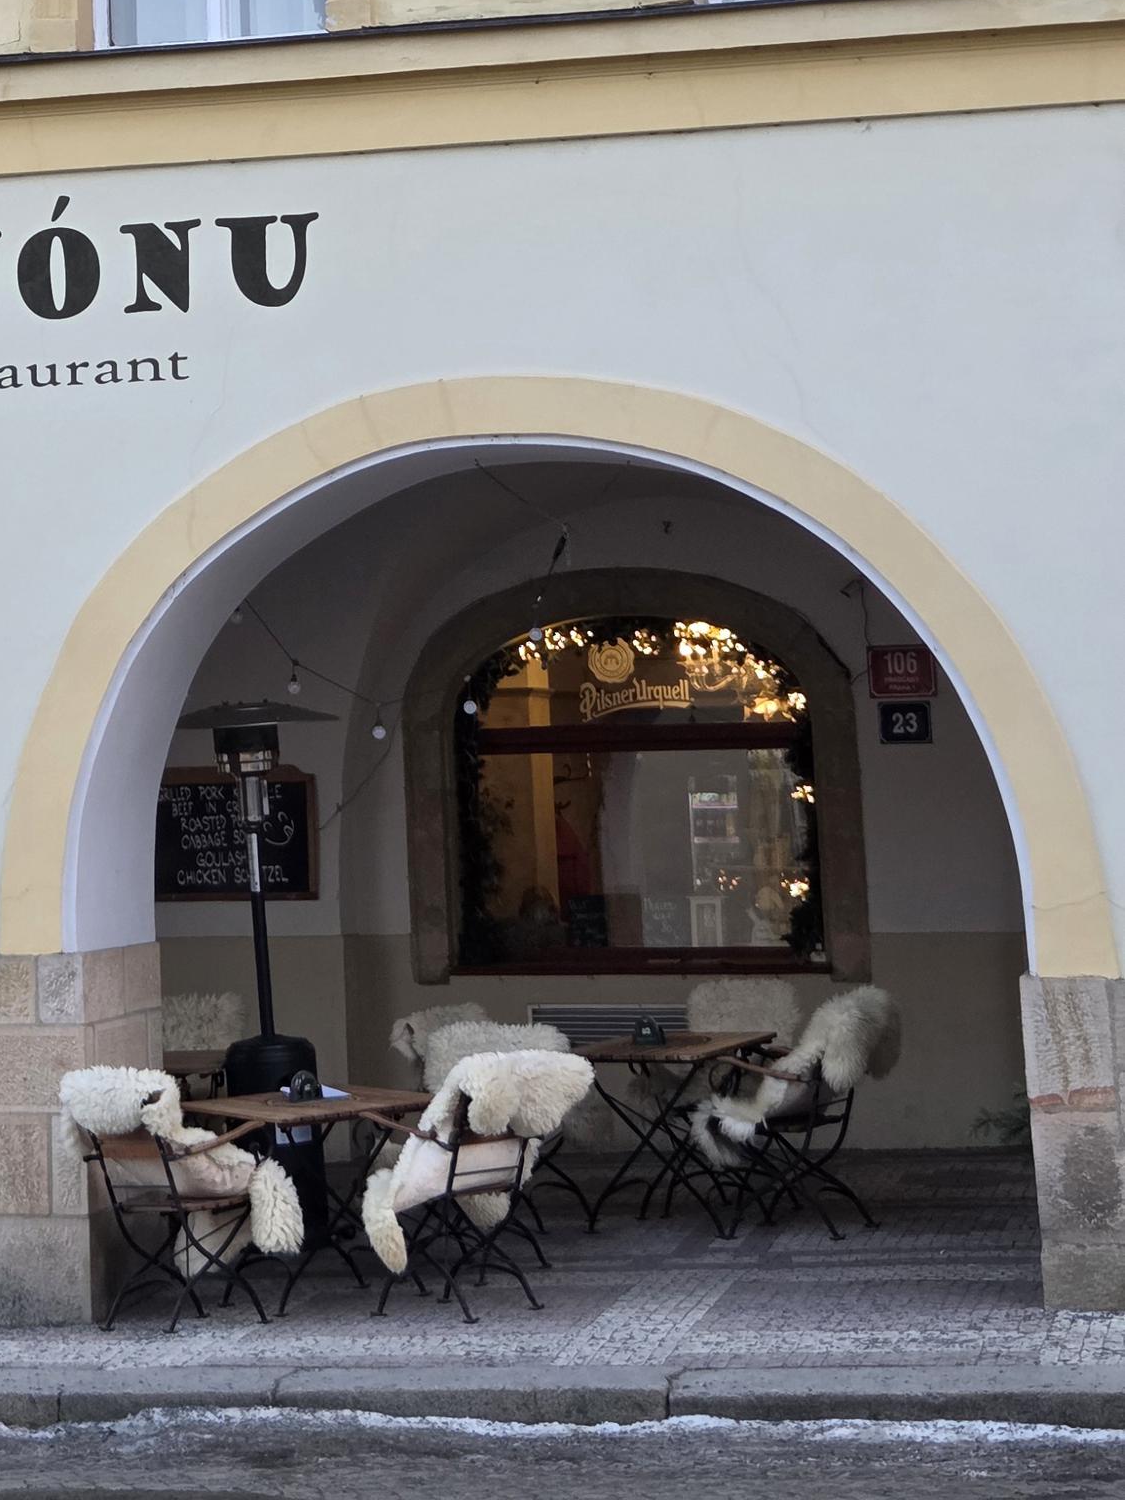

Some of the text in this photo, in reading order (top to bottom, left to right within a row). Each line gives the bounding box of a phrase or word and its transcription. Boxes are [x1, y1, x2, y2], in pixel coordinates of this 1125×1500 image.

[883, 651, 917, 674] 106
[579, 677, 690, 723] Pilsner Urquell
[892, 712, 918, 734] 23
[198, 785, 225, 801] PORK
[172, 801, 194, 817] BEEF
[181, 813, 227, 832] ROASTED
[177, 868, 227, 885] CHICKEN
